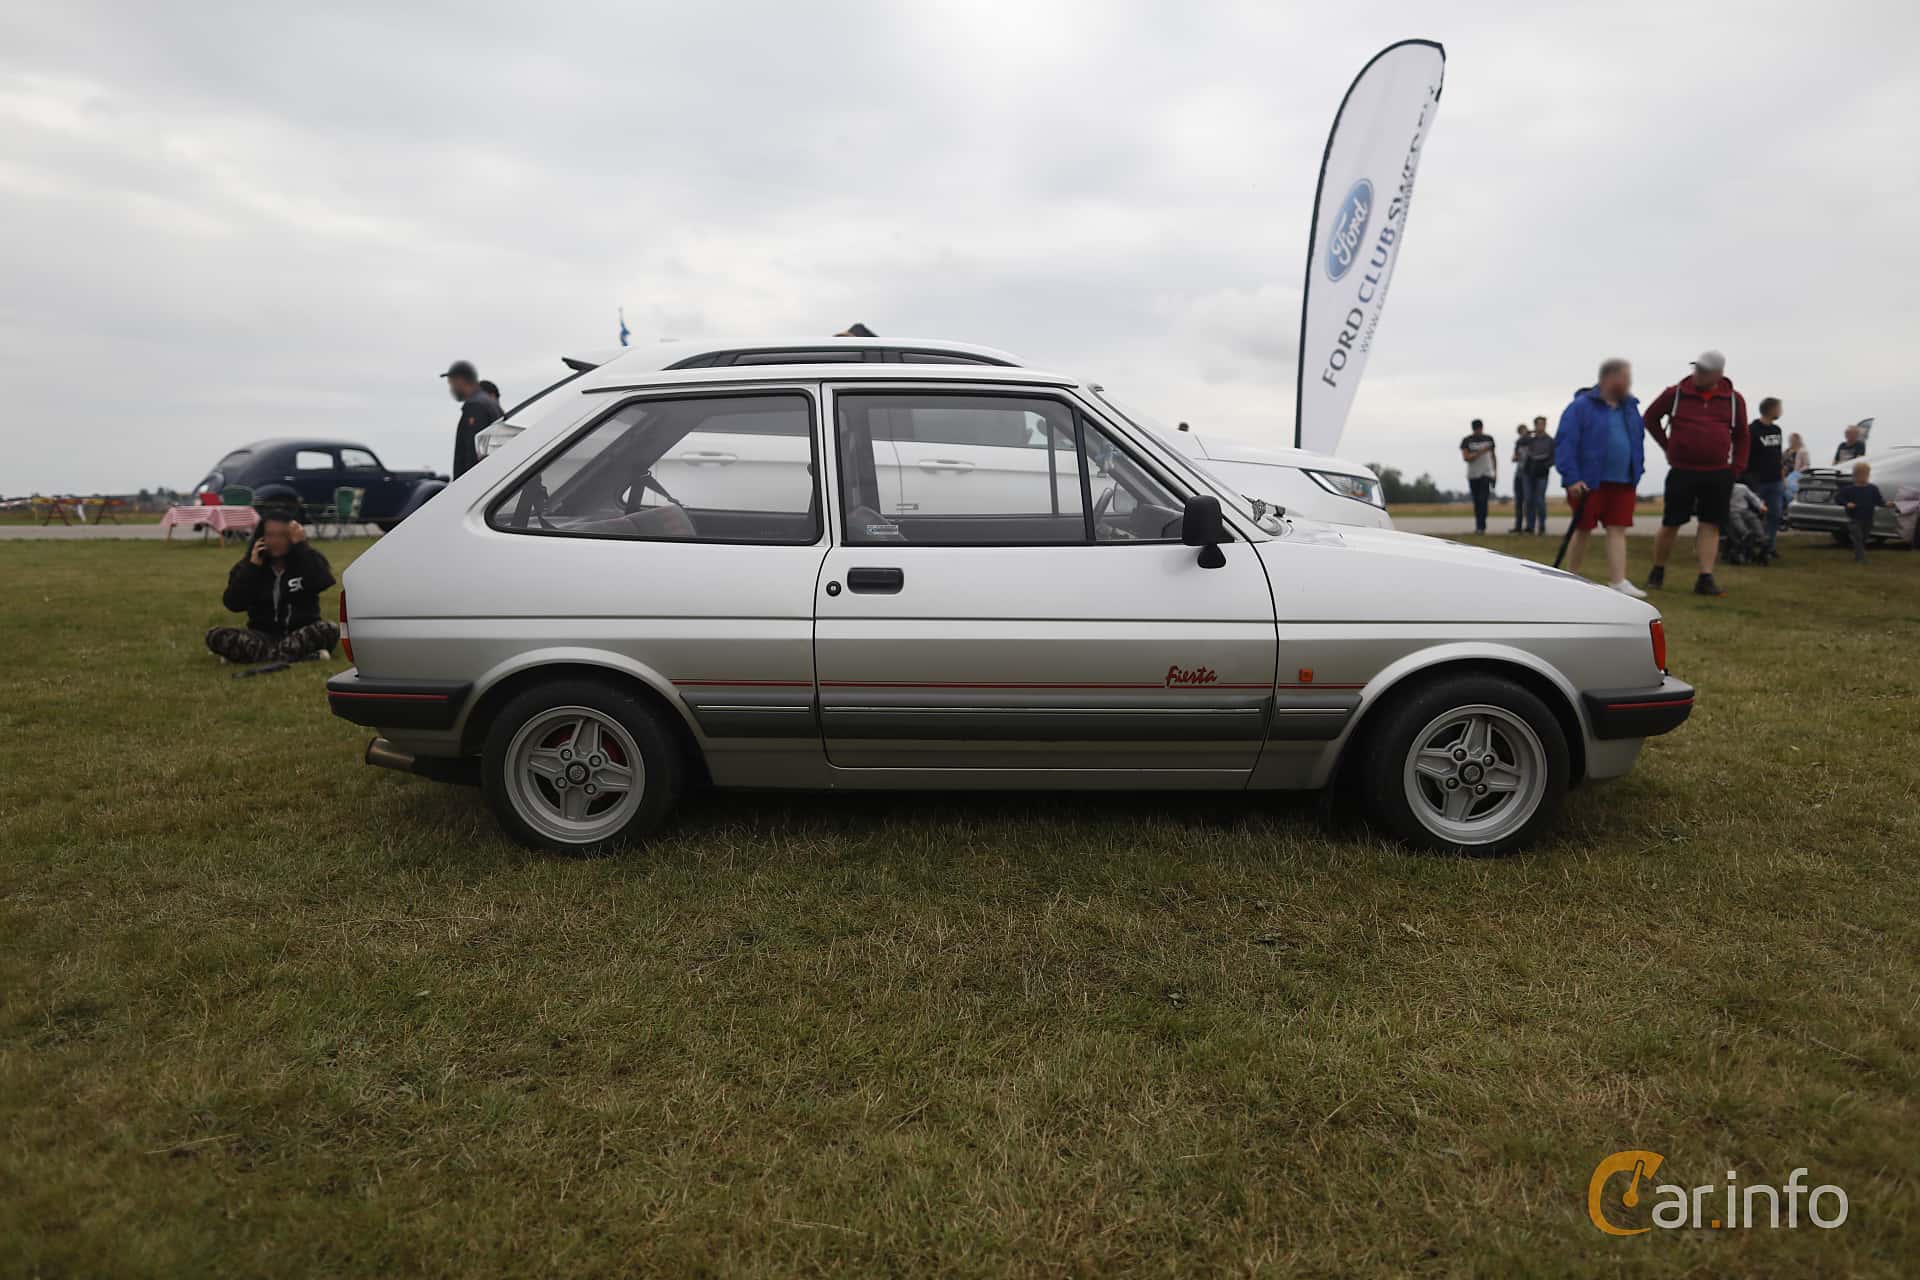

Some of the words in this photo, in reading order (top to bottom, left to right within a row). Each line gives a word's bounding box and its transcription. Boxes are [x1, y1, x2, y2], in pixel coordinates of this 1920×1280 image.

[1331, 197, 1368, 266] Ford
[1322, 307, 1365, 388] FORD
[1358, 227, 1396, 304] CLUB
[1165, 665, 1218, 687] Fiesta
